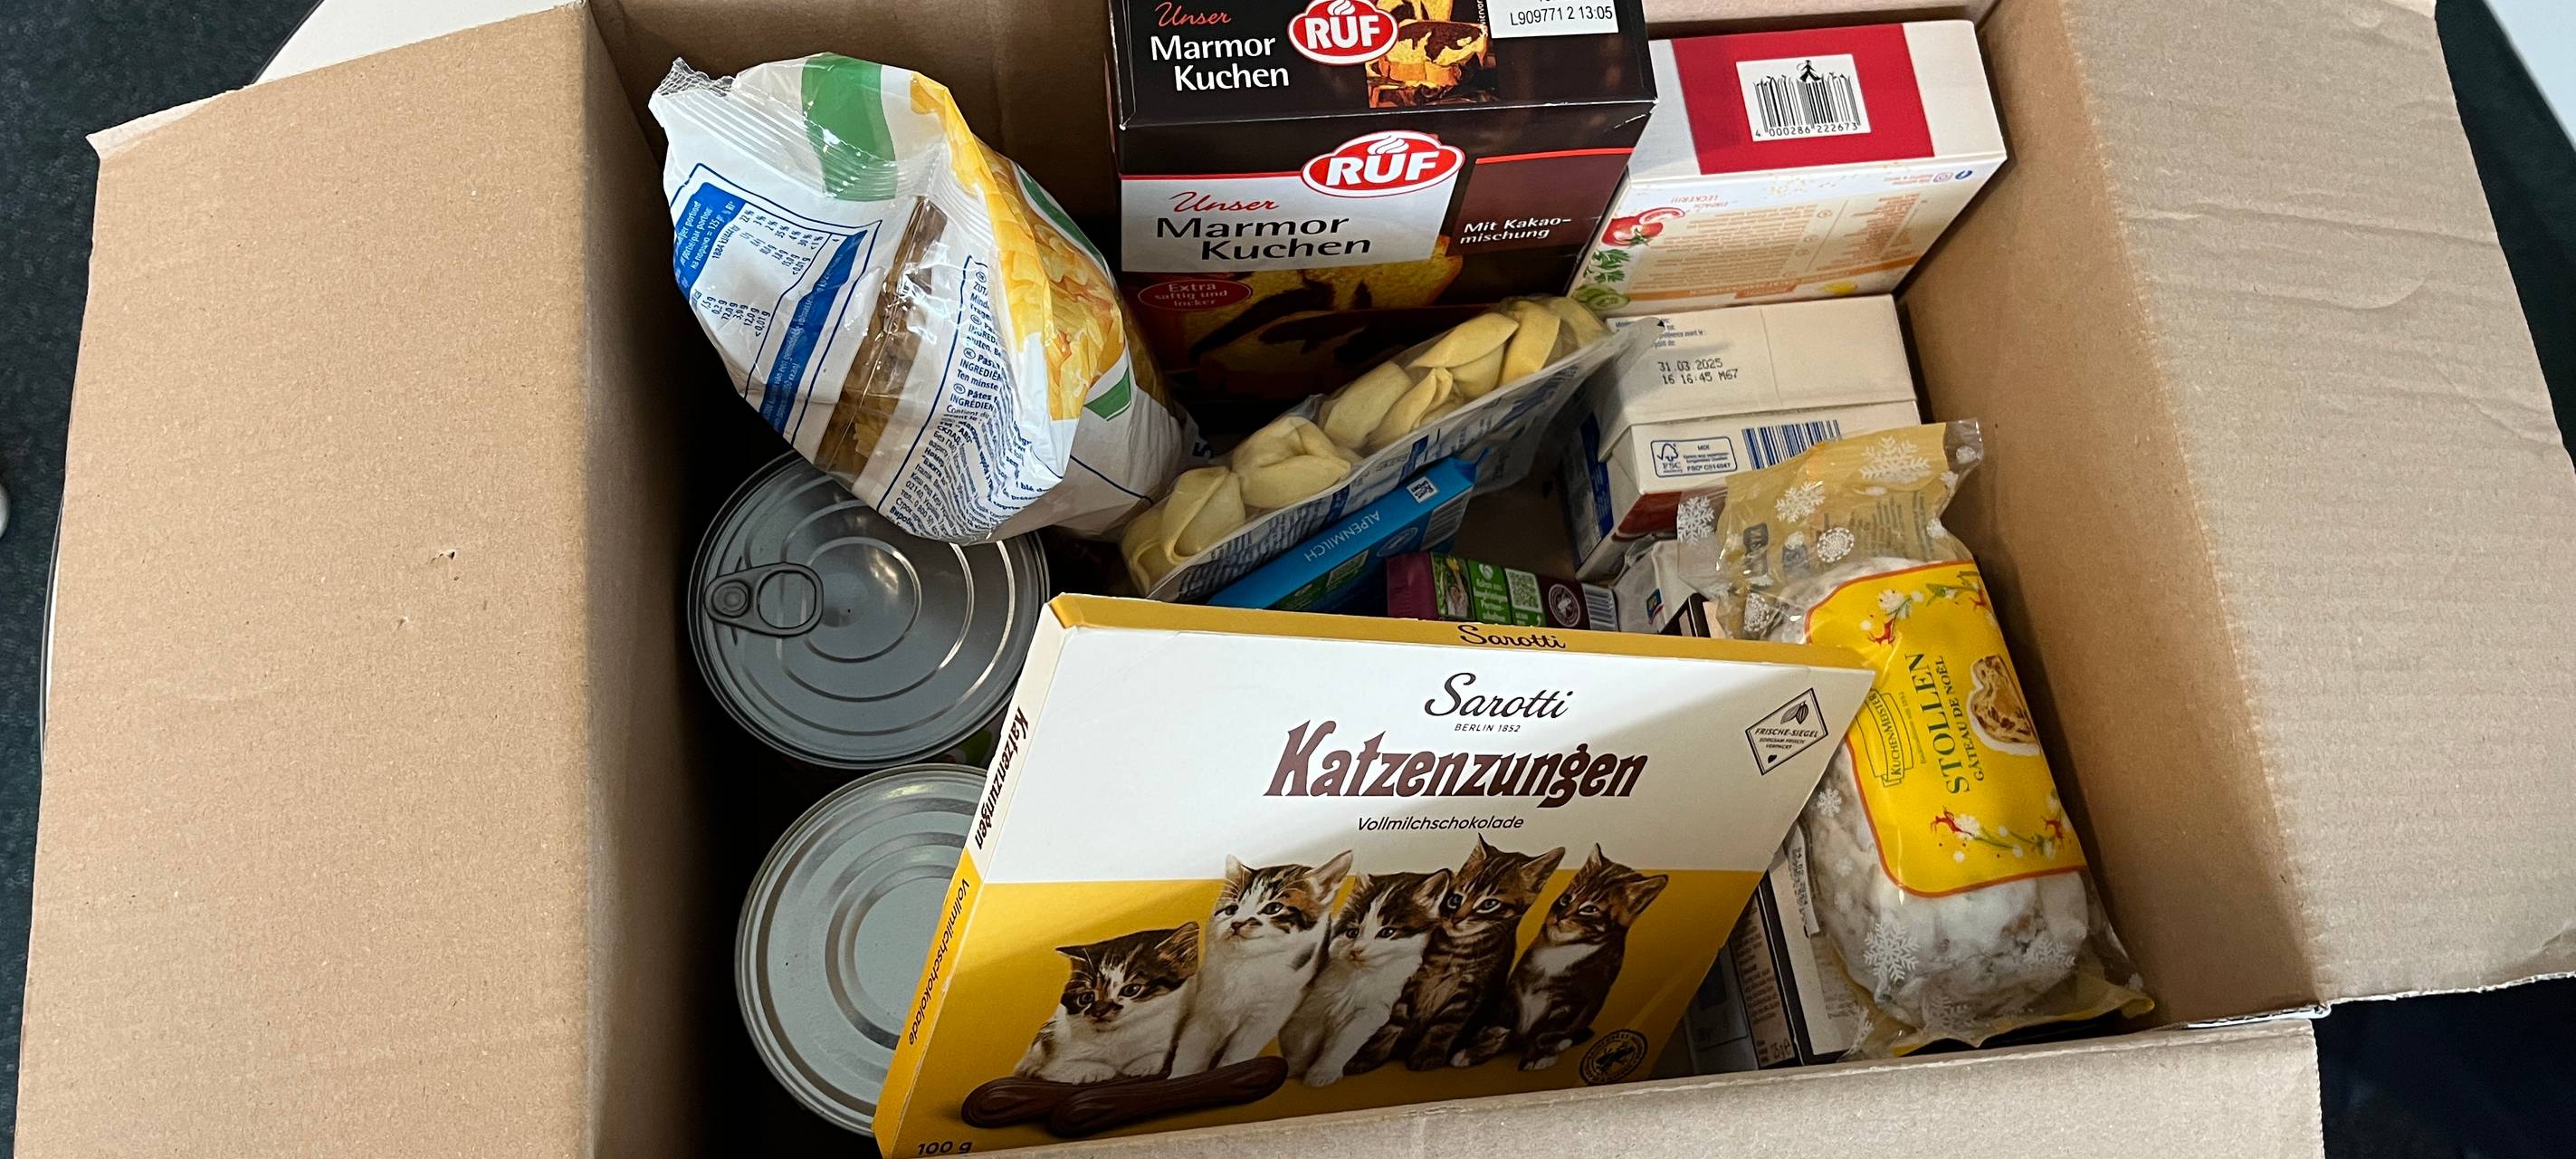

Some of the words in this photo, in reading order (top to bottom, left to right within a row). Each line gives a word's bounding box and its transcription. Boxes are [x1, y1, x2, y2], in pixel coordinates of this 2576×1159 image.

[1155, 2, 1232, 27] Unser
[1510, 7, 1563, 25] L909771
[1567, 6, 1575, 20] 2
[1579, 5, 1613, 19] 13:05
[1305, 15, 1381, 49] RUF
[1150, 35, 1275, 61] Marmor
[1175, 63, 1289, 91] Kuchen
[1755, 129, 1761, 138] 4
[1769, 125, 1811, 137] 000286
[1817, 121, 1858, 133] 222673
[1326, 151, 1439, 187] RUF
[1169, 191, 1279, 213] Unser
[1157, 217, 1350, 239] Marmor
[1459, 228, 1550, 244] mischung
[1464, 222, 1498, 234] Mit
[1503, 217, 1572, 229] Kakao-
[1201, 238, 1371, 261] Kuchen
[1168, 282, 1216, 293] Extra
[957, 369, 968, 381] Ten
[971, 377, 998, 390] minste
[1304, 511, 1380, 562] ALPENMILCH
[1457, 624, 1567, 649] Sarotti
[1935, 656, 1955, 694] NOËL
[1425, 672, 1574, 719] Sarotti
[1949, 696, 1963, 718] DE
[1455, 723, 1494, 733] BERLIN
[1497, 723, 1522, 733] 1852
[1754, 728, 1819, 738] FRISCHE-SIEGEL
[1905, 653, 1970, 794] STOLLEN
[1263, 718, 1649, 809] Katzenzungen
[975, 705, 1029, 850] Katzenzungen
[1357, 814, 1524, 831] Vollmilchschokolade
[907, 877, 969, 1046] Vollmilchschokolade
[918, 1141, 953, 1155] 100
[959, 1142, 973, 1154] g
